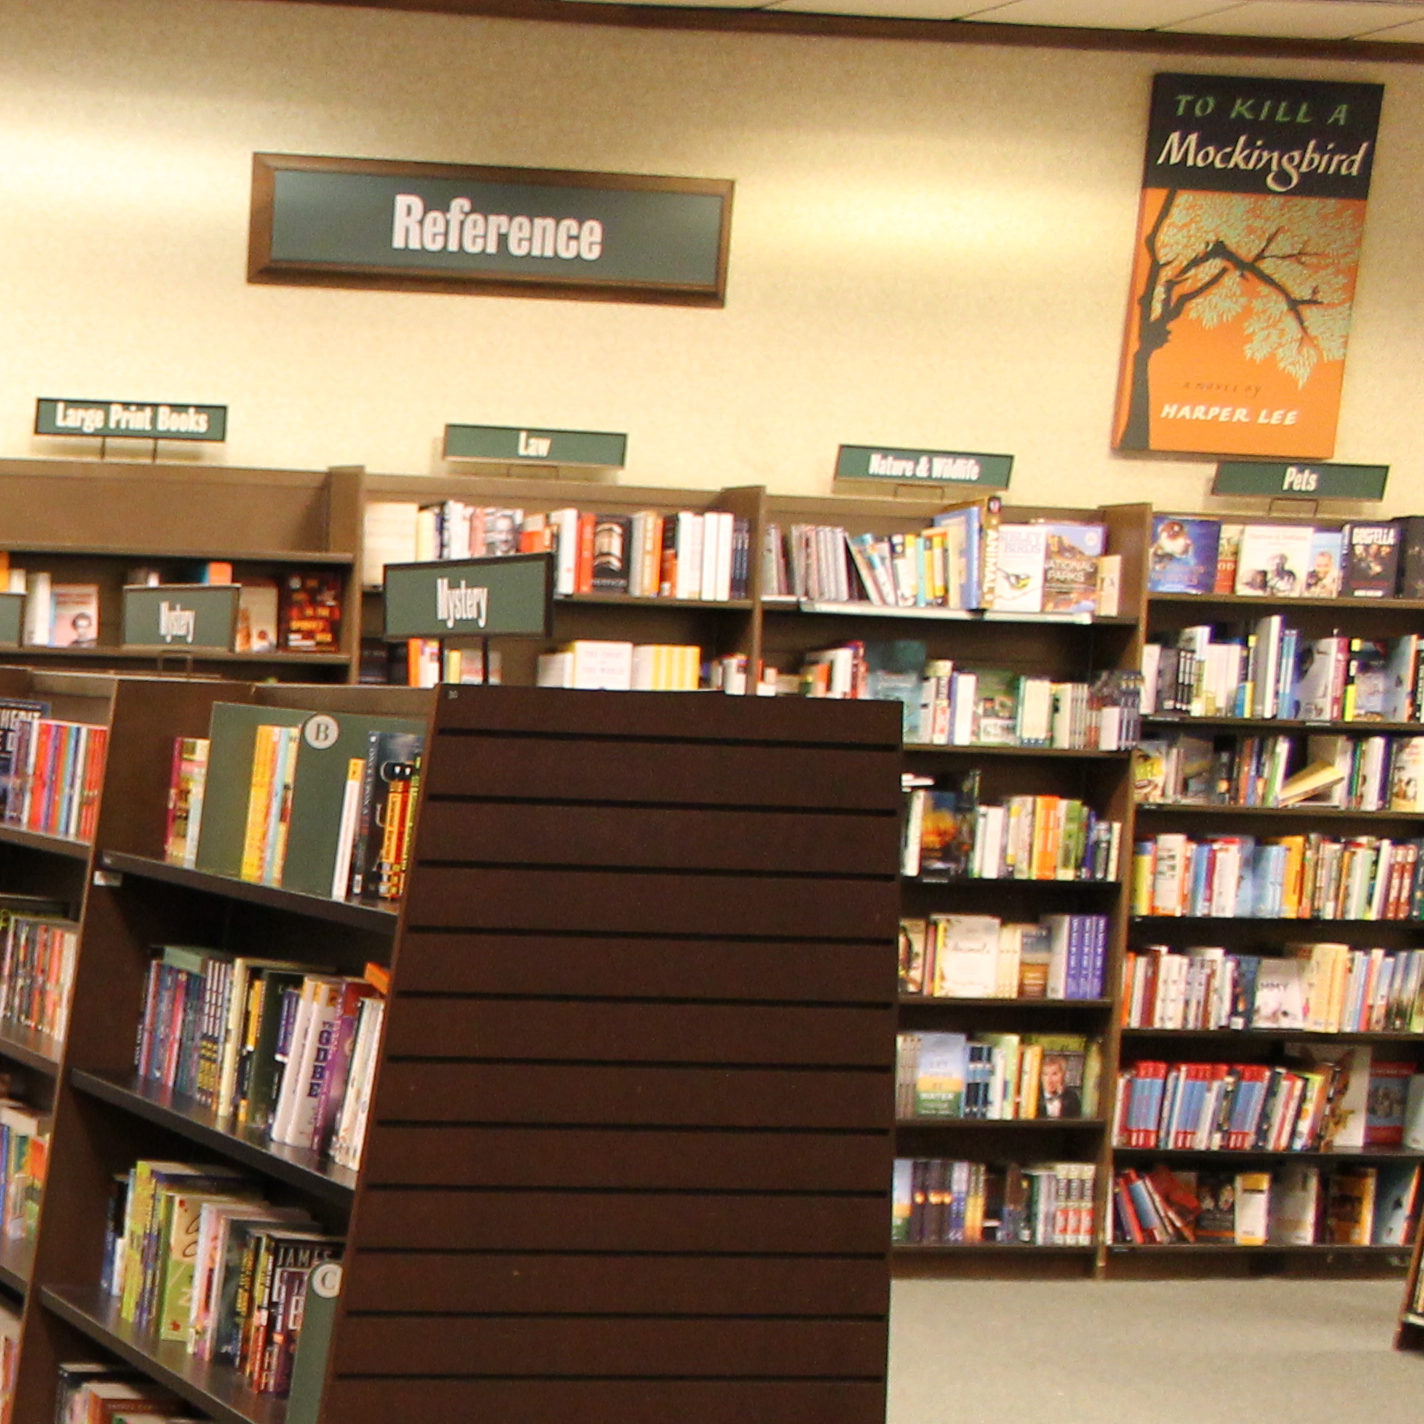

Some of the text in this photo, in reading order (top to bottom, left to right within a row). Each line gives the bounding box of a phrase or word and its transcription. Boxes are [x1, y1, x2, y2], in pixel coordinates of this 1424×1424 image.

[1174, 94, 1348, 126] TO KILL A
[1157, 130, 1368, 192] Mockingbird
[391, 193, 604, 261] Reference
[55, 401, 209, 433] Large Print Books
[1160, 403, 1298, 426] HARPER LEE
[518, 430, 551, 459] Law
[868, 453, 981, 481] Nature & Wildlife
[1282, 466, 1318, 492] Pets
[436, 577, 489, 629] Mystery
[315, 722, 330, 742] B
[321, 1269, 338, 1290] C
